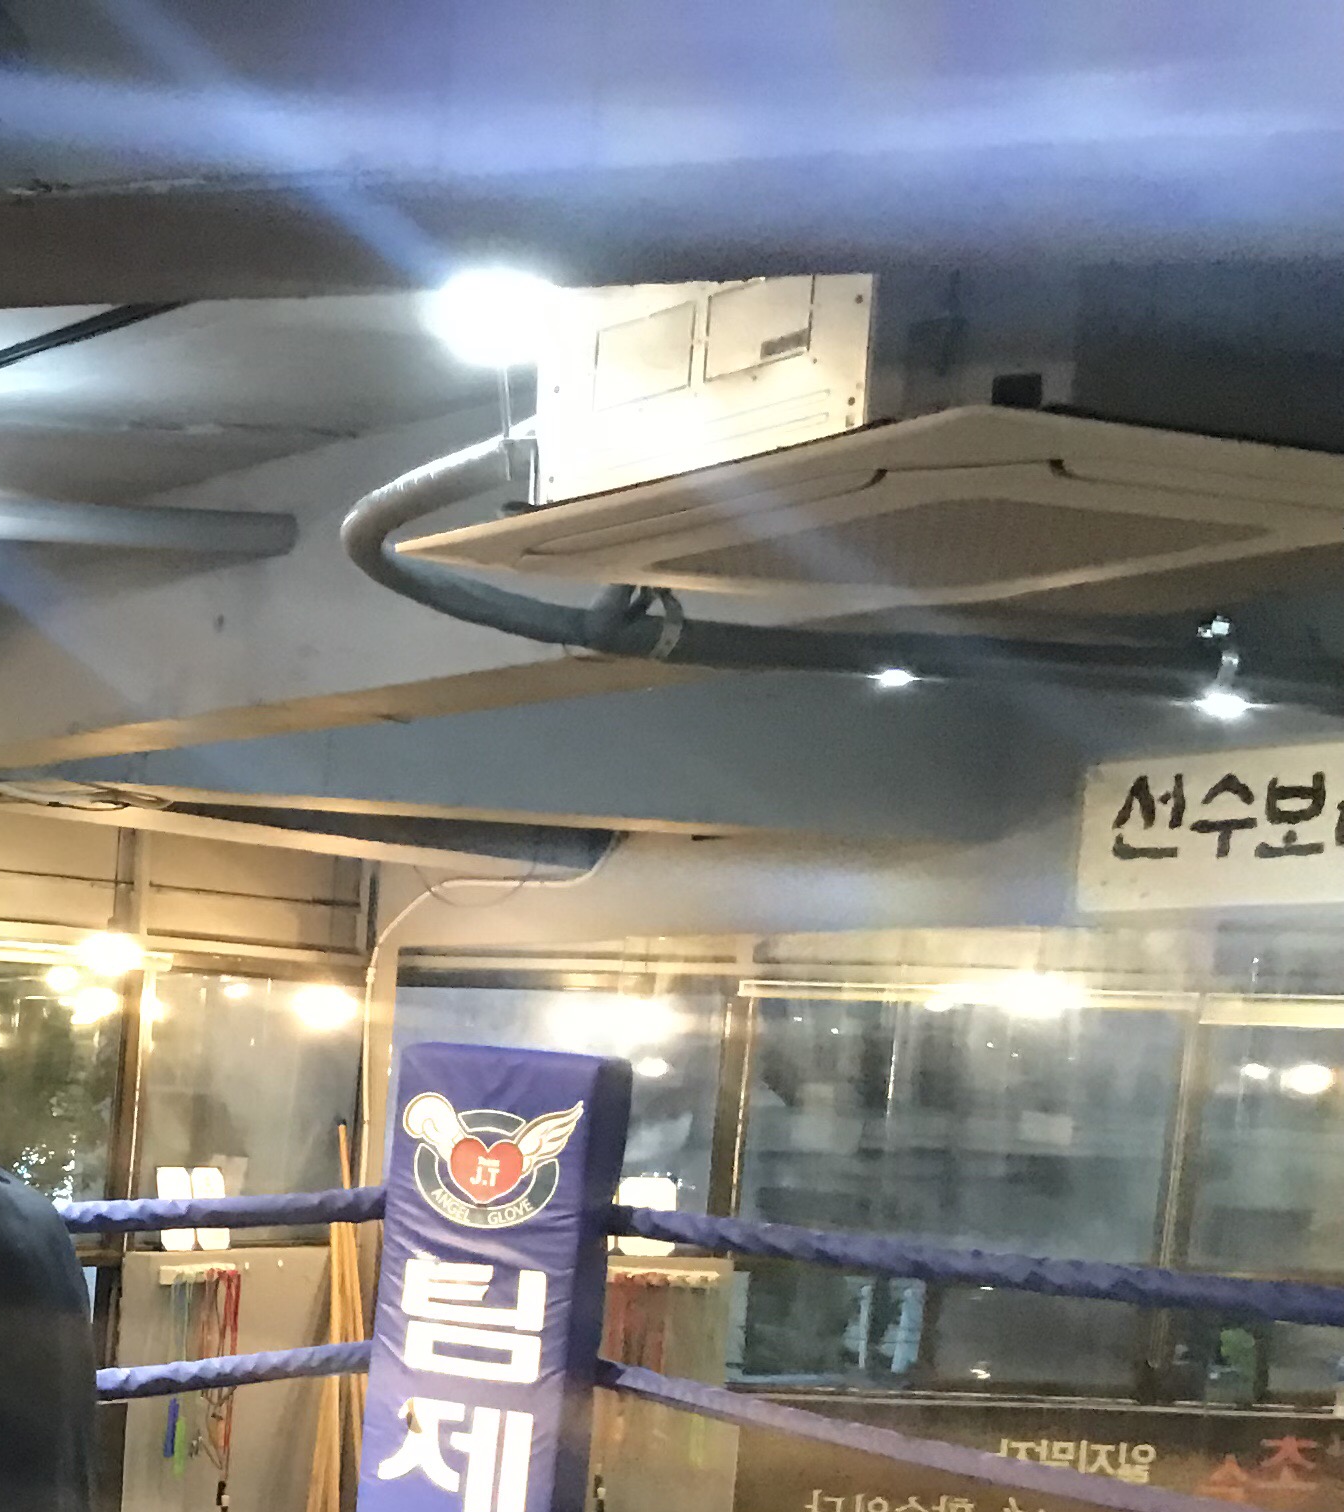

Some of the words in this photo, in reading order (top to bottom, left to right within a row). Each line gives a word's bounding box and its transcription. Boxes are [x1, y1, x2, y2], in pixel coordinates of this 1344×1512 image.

[1112, 771, 1344, 860] 선수보
[431, 1187, 471, 1223] ANGEL
[487, 1199, 534, 1225] GLOVE
